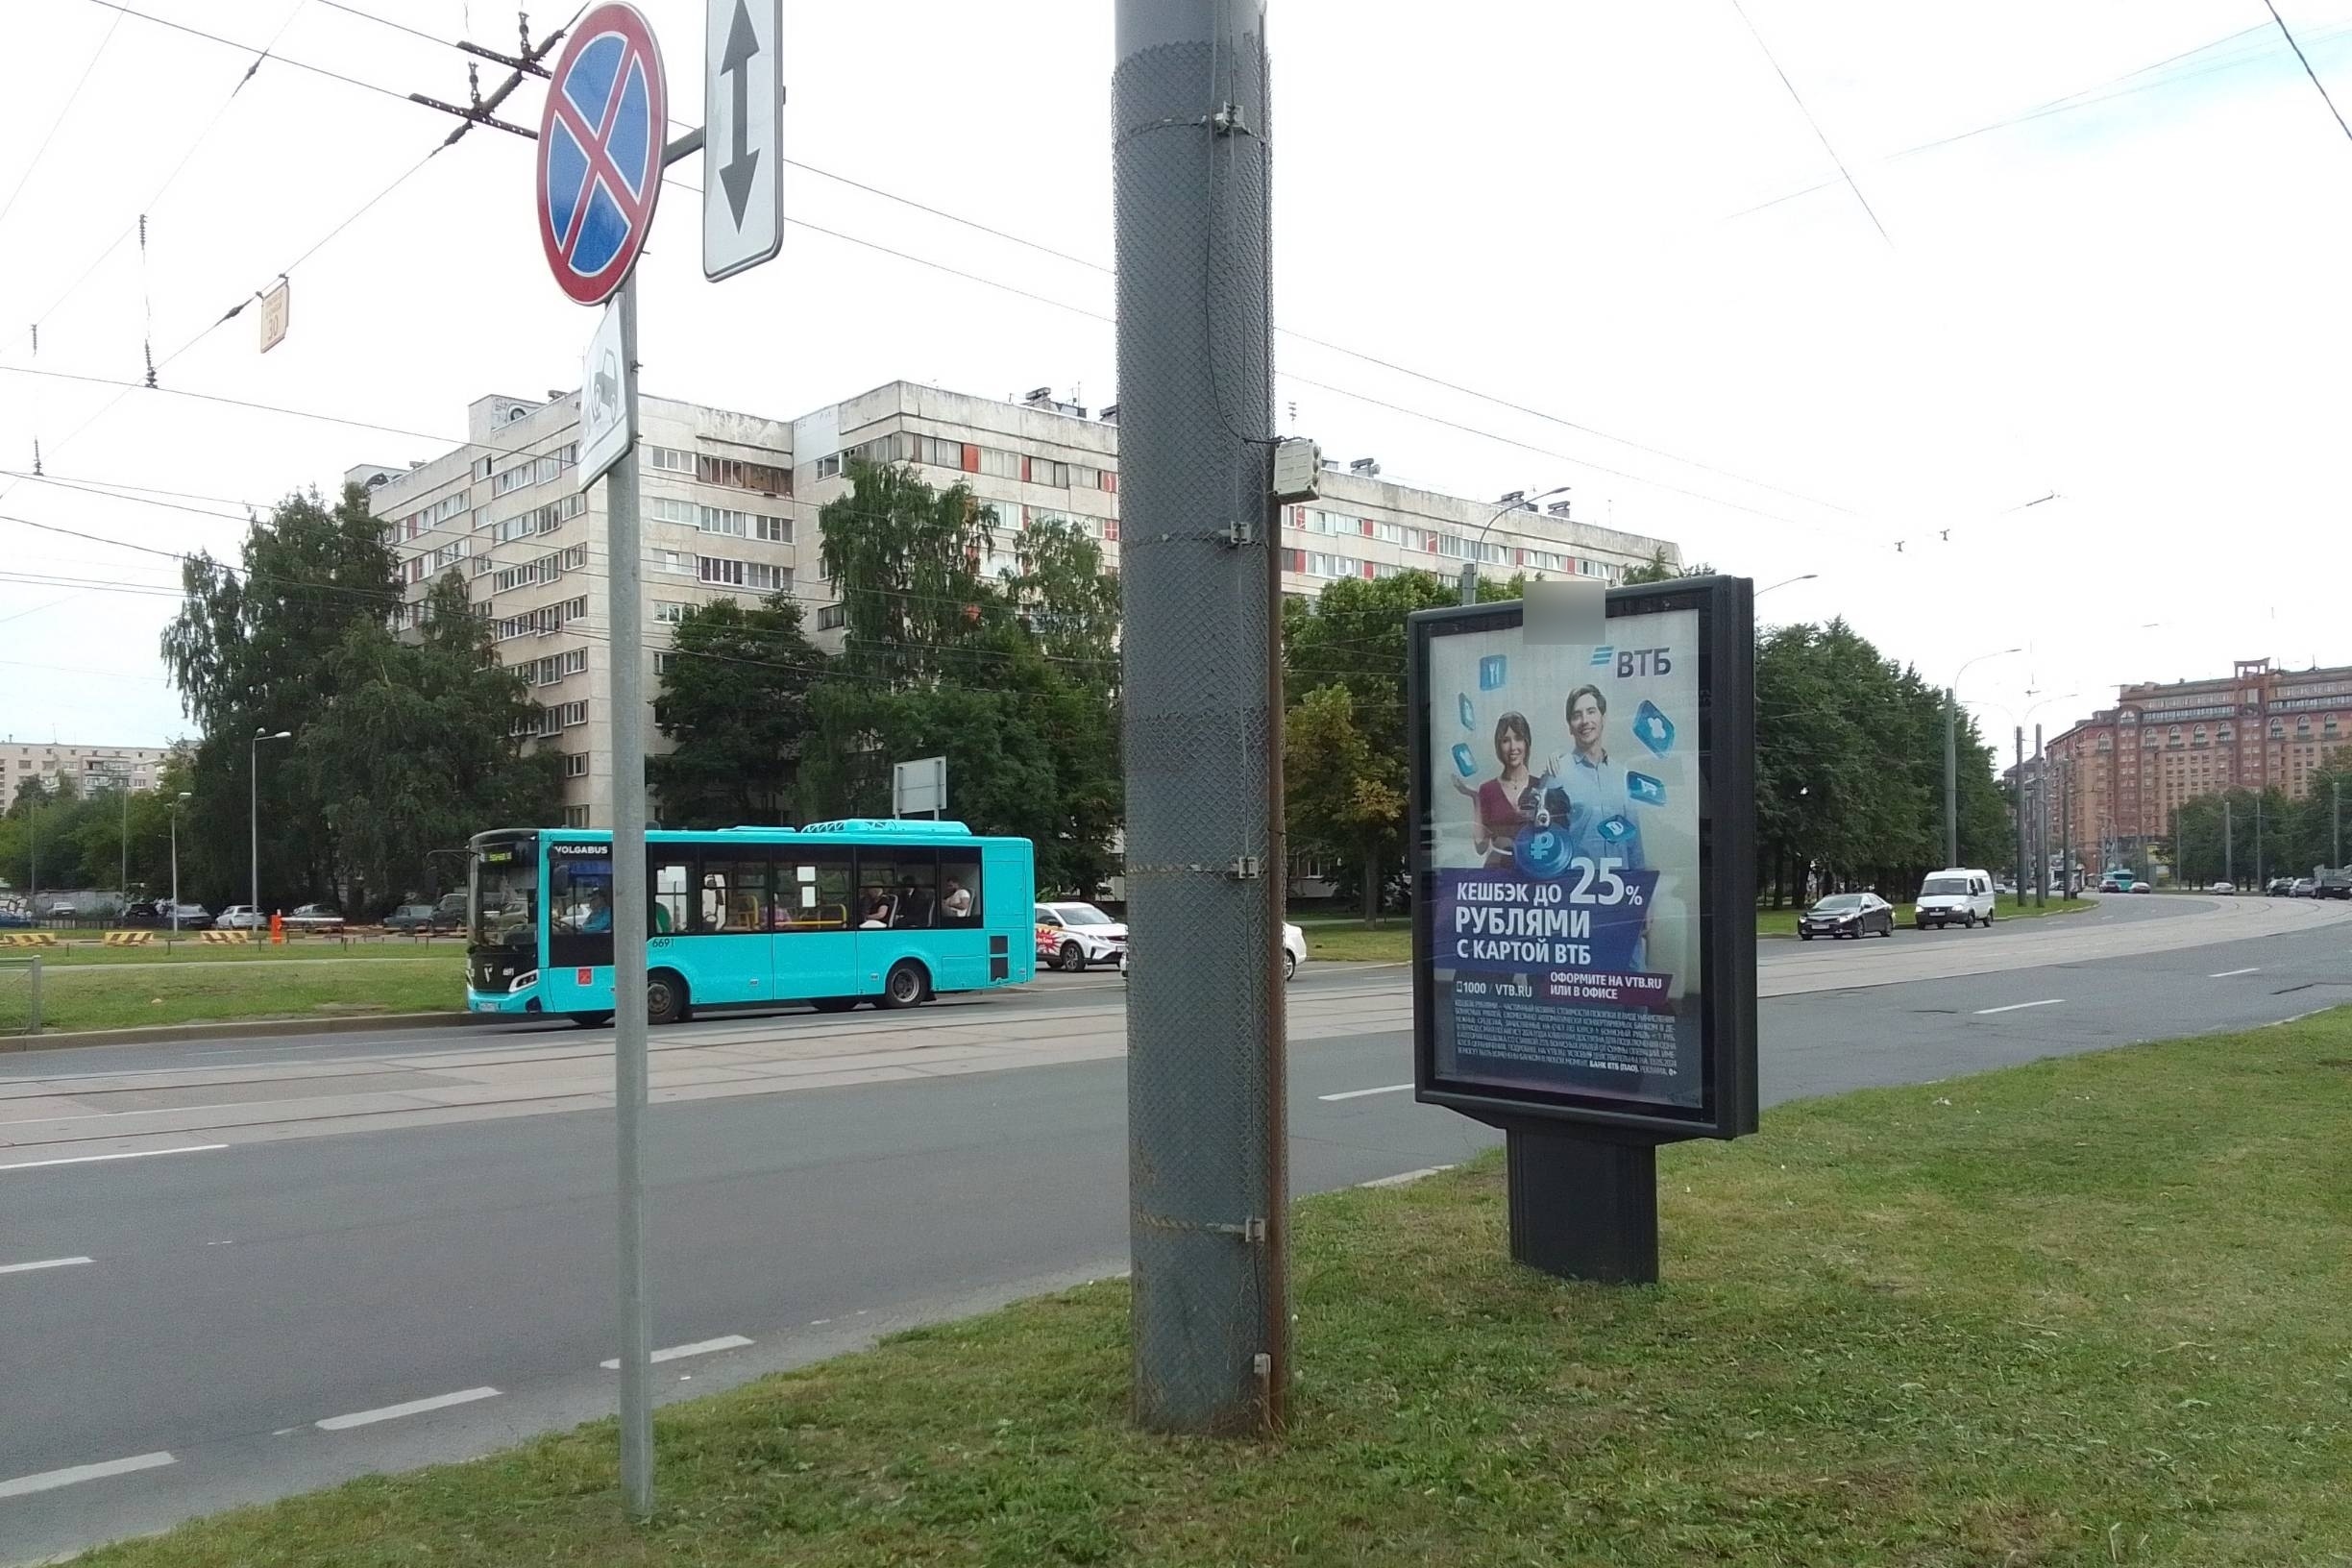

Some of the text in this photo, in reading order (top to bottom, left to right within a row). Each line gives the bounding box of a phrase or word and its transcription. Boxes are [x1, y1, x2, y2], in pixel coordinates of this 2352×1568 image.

[1616, 647, 1672, 679] ВТБ
[554, 845, 609, 855] VOLGABUS
[1457, 856, 1643, 907] КЕШБЭК ДО 25%
[1455, 906, 1591, 939] РУБЛЯМИ
[652, 938, 674, 948] 6691
[1457, 938, 1592, 966] С КАРТОЙ ВТБ
[1462, 982, 1487, 994] 1000
[1495, 983, 1532, 998] VTB.RU
[1550, 971, 1662, 991] ОФОРМИТЕ НА VTB.RU
[1550, 985, 1619, 1000] ИЛИ В ОФИСЕ
